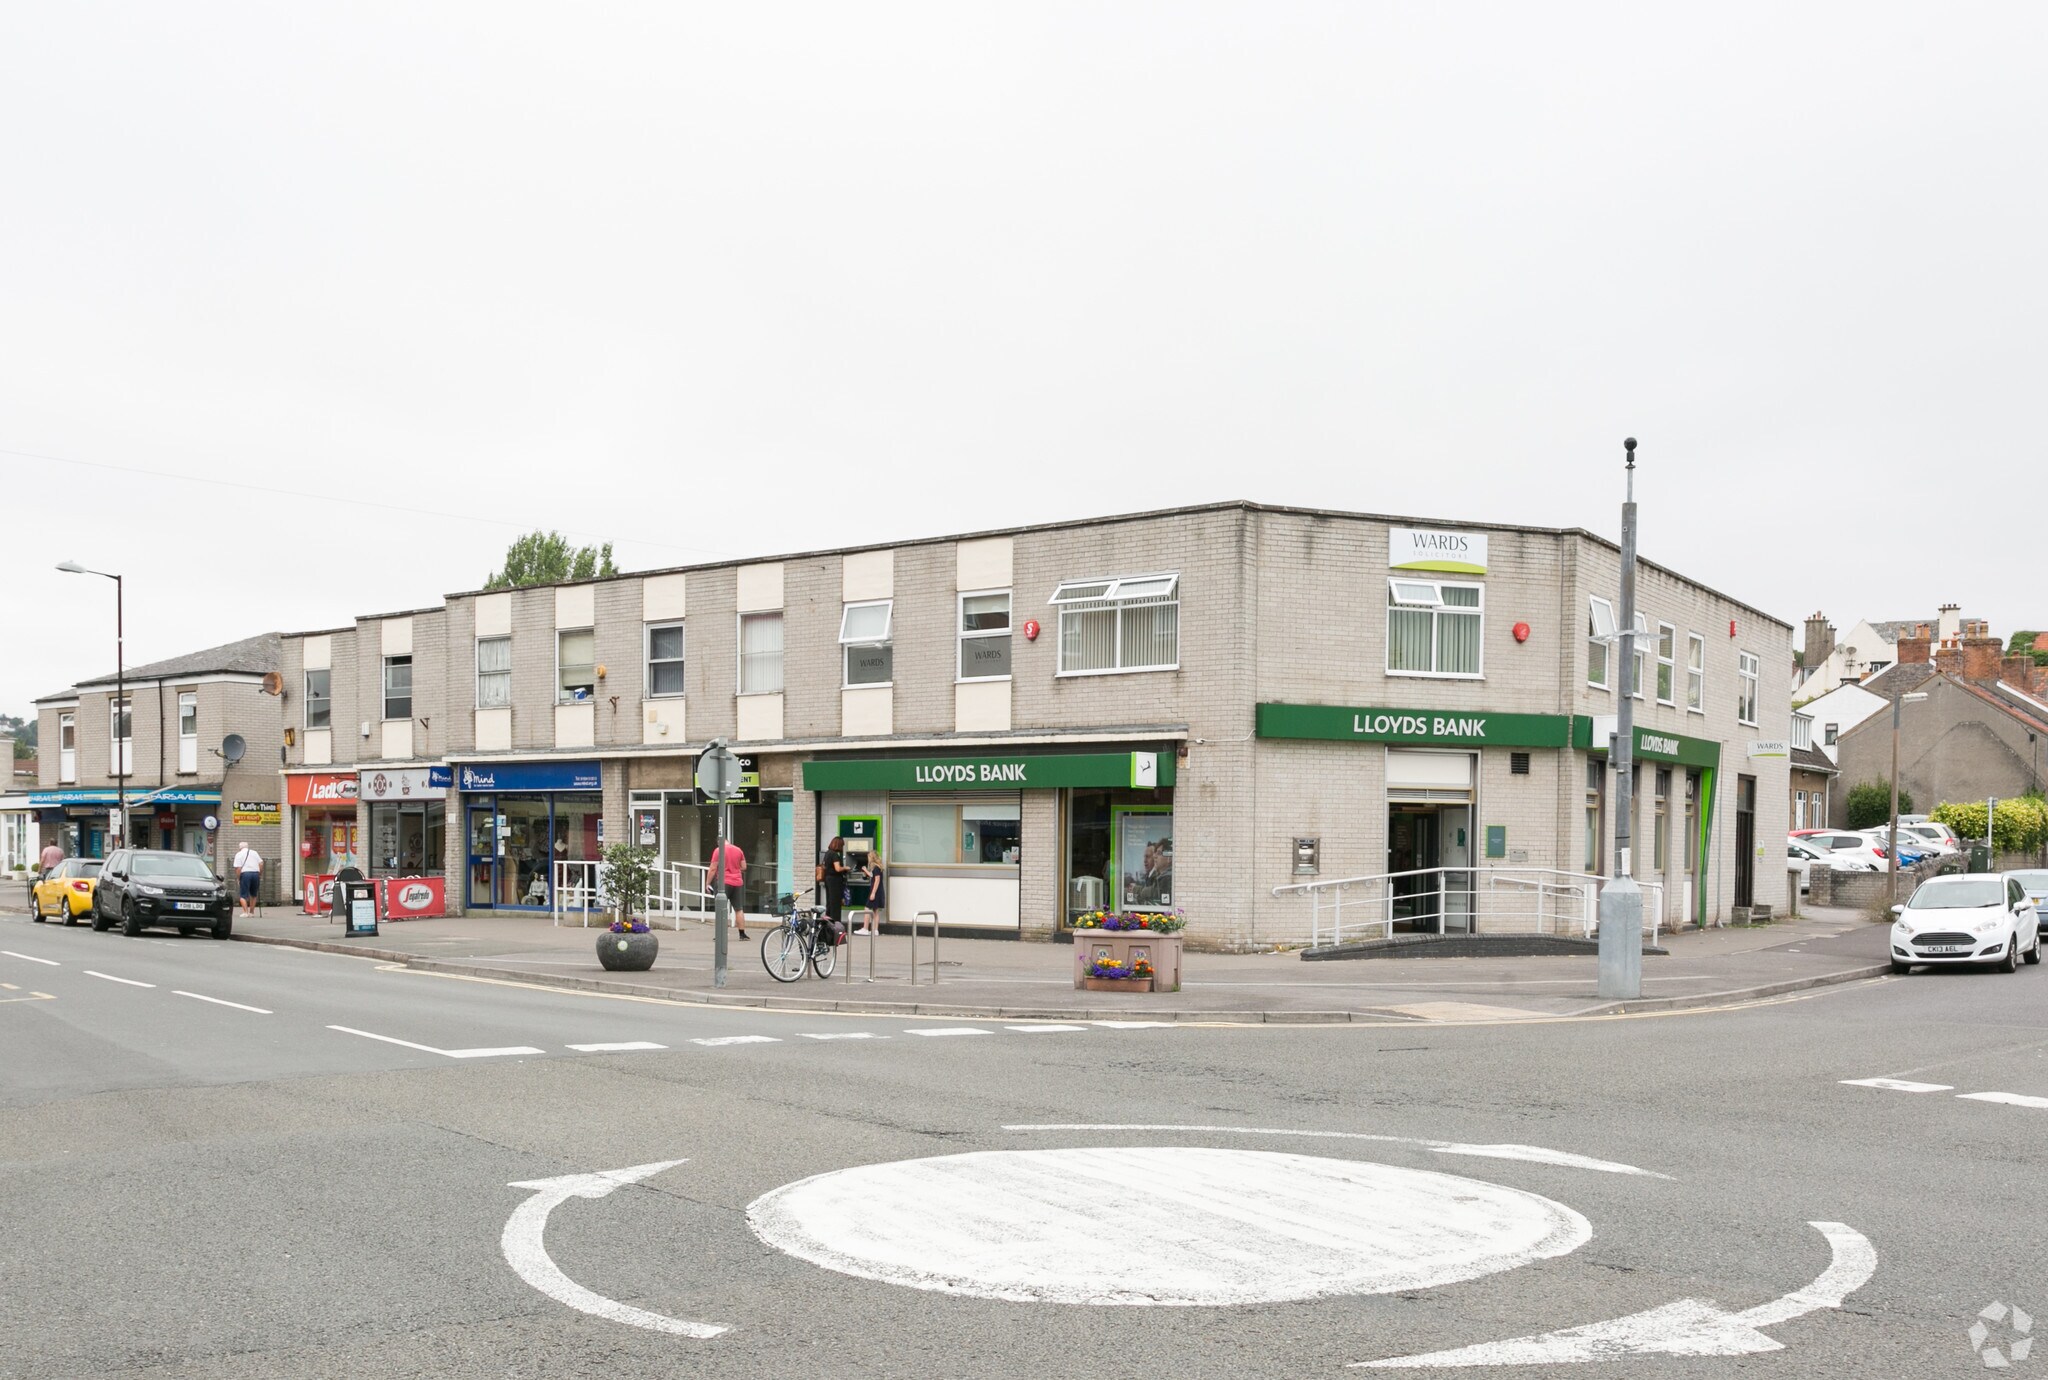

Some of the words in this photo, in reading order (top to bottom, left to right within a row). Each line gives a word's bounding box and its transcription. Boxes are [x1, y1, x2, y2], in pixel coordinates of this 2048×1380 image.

[1412, 533, 1468, 551] WARDS
[1413, 550, 1468, 559] SOLICITORS
[974, 650, 1002, 660] WARDS
[859, 658, 884, 667] WARDS
[1353, 714, 1427, 735] LLOYDS
[1432, 717, 1486, 737] BANK
[1640, 734, 1663, 753] LLOYDS
[1662, 738, 1679, 756] BANK
[1756, 742, 1784, 750] WARDS
[473, 773, 495, 783] Mind
[916, 765, 976, 782] LLOYDS
[980, 764, 1027, 781] BANK
[403, 887, 430, 903] Segafredo
